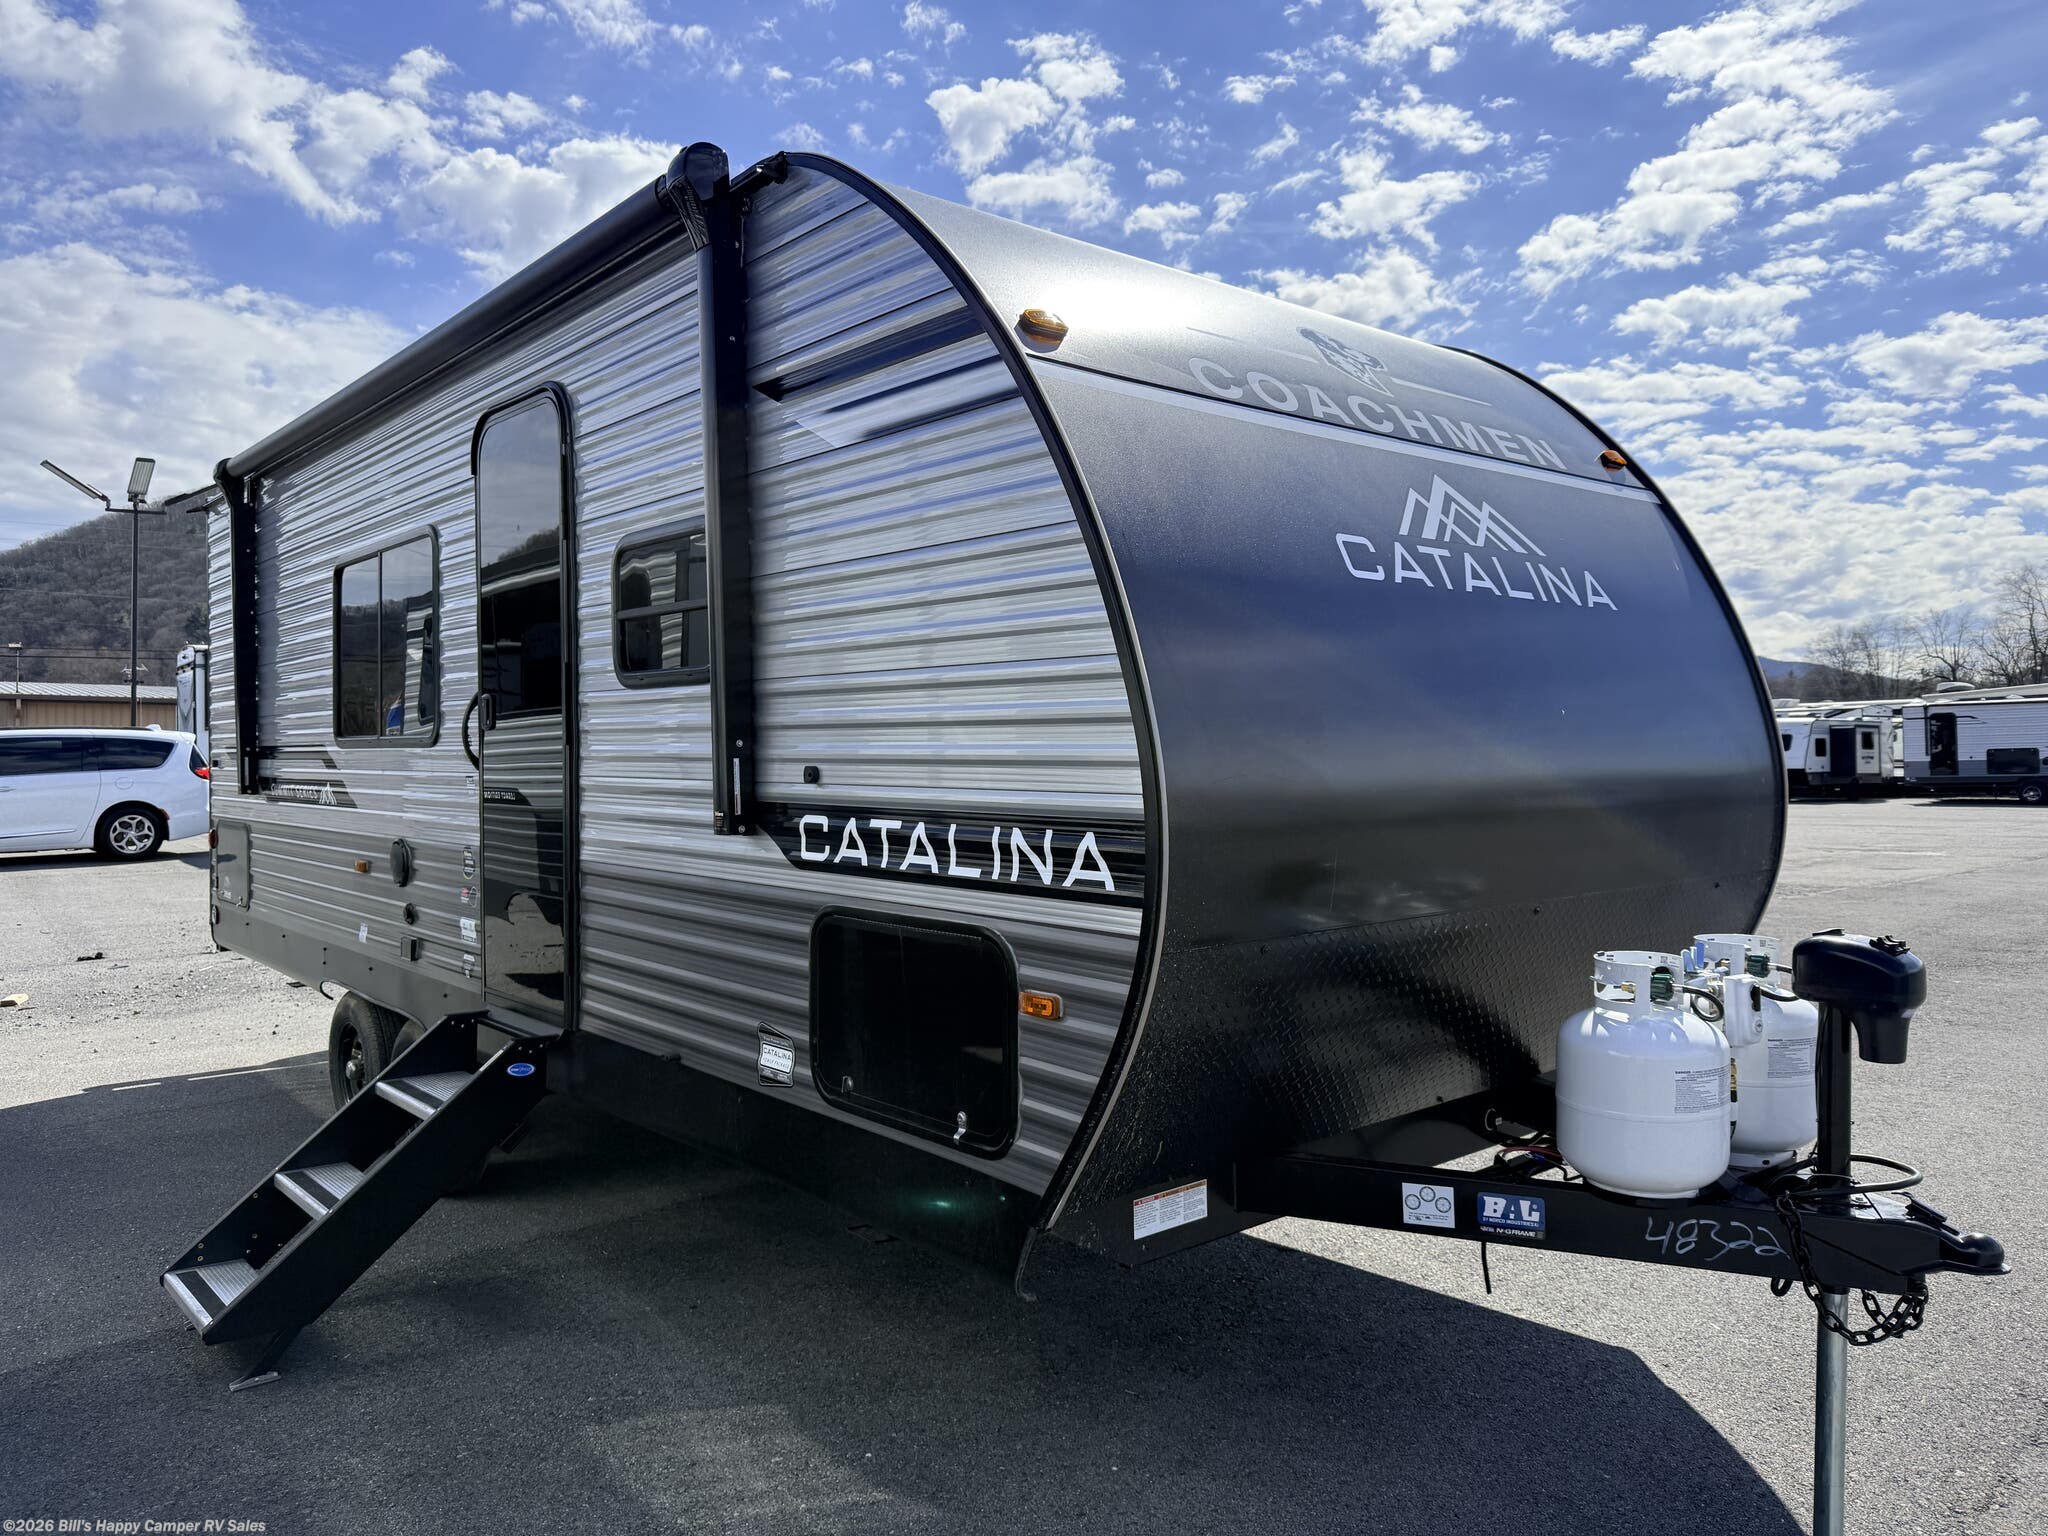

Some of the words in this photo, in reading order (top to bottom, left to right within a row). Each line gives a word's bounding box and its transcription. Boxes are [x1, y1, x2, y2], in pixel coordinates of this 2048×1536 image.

[1188, 357, 1568, 471] COACHMEN
[1335, 532, 1618, 611] CATALINA
[799, 814, 1116, 892] CATALINA
[763, 1046, 791, 1060] CATALINA
[1483, 1195, 1540, 1222] BAL
[1644, 1216, 1791, 1261] 48322
